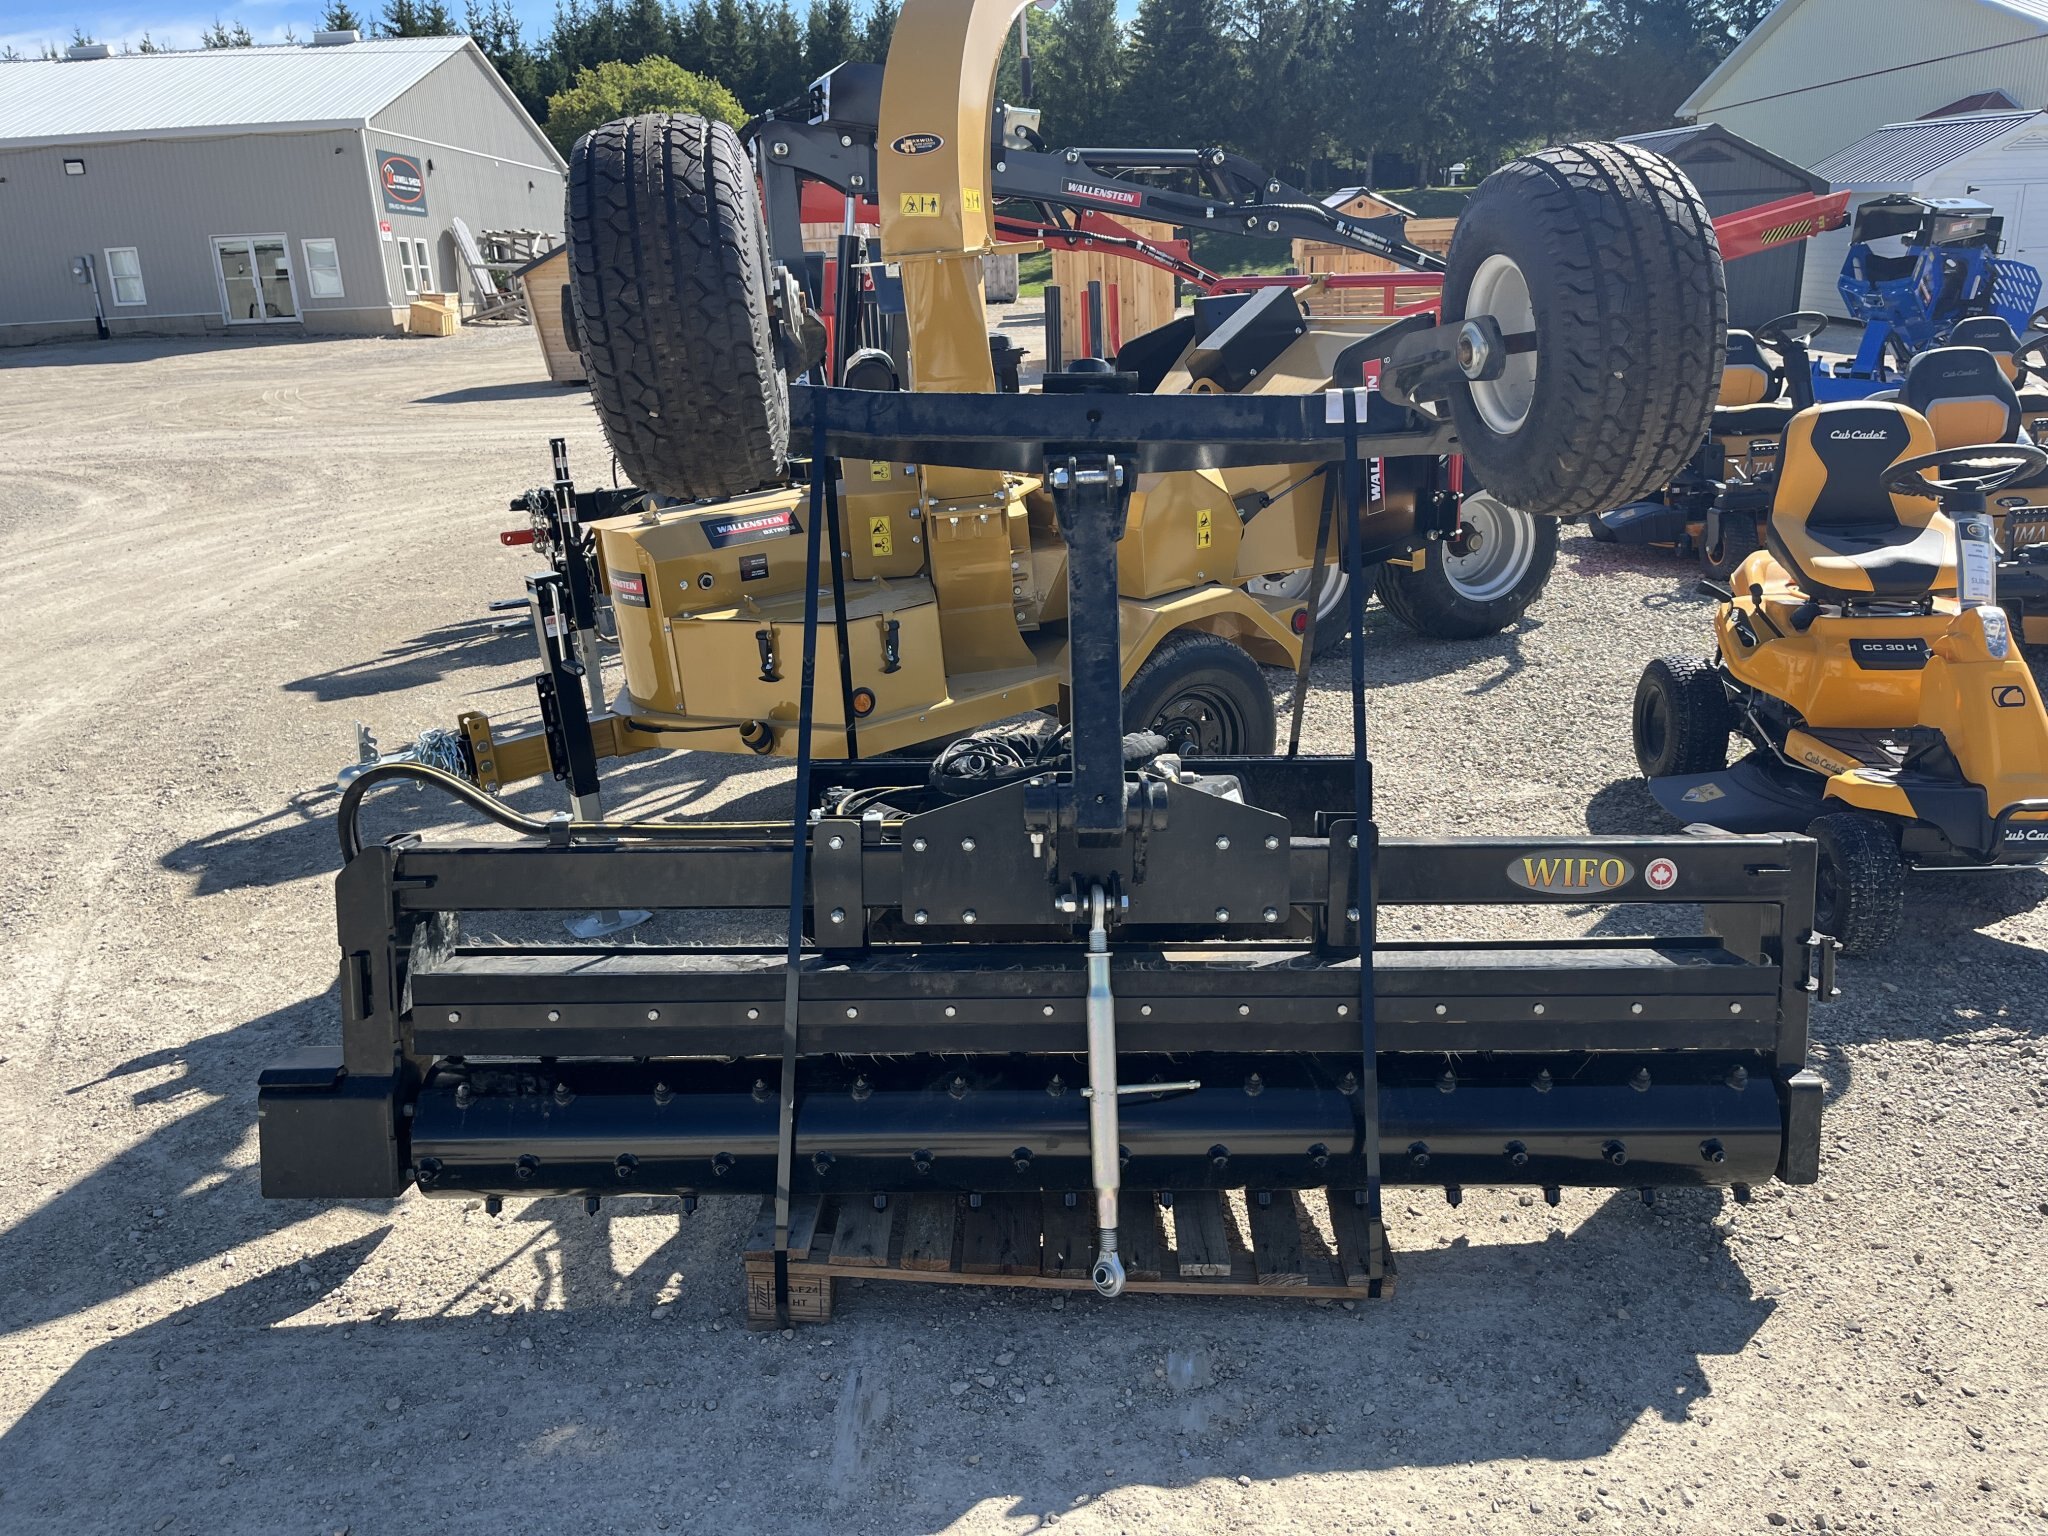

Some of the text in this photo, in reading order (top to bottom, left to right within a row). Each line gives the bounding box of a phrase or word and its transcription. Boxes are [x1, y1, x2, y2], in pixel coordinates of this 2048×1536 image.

[1067, 182, 1135, 203] WALLENSTEIN
[1830, 429, 1888, 440] Cub Cadet
[716, 515, 785, 534] WALLENSTEIN
[1804, 751, 1820, 765] Cub
[1522, 857, 1626, 888] WIFO
[792, 1299, 808, 1307] HT
